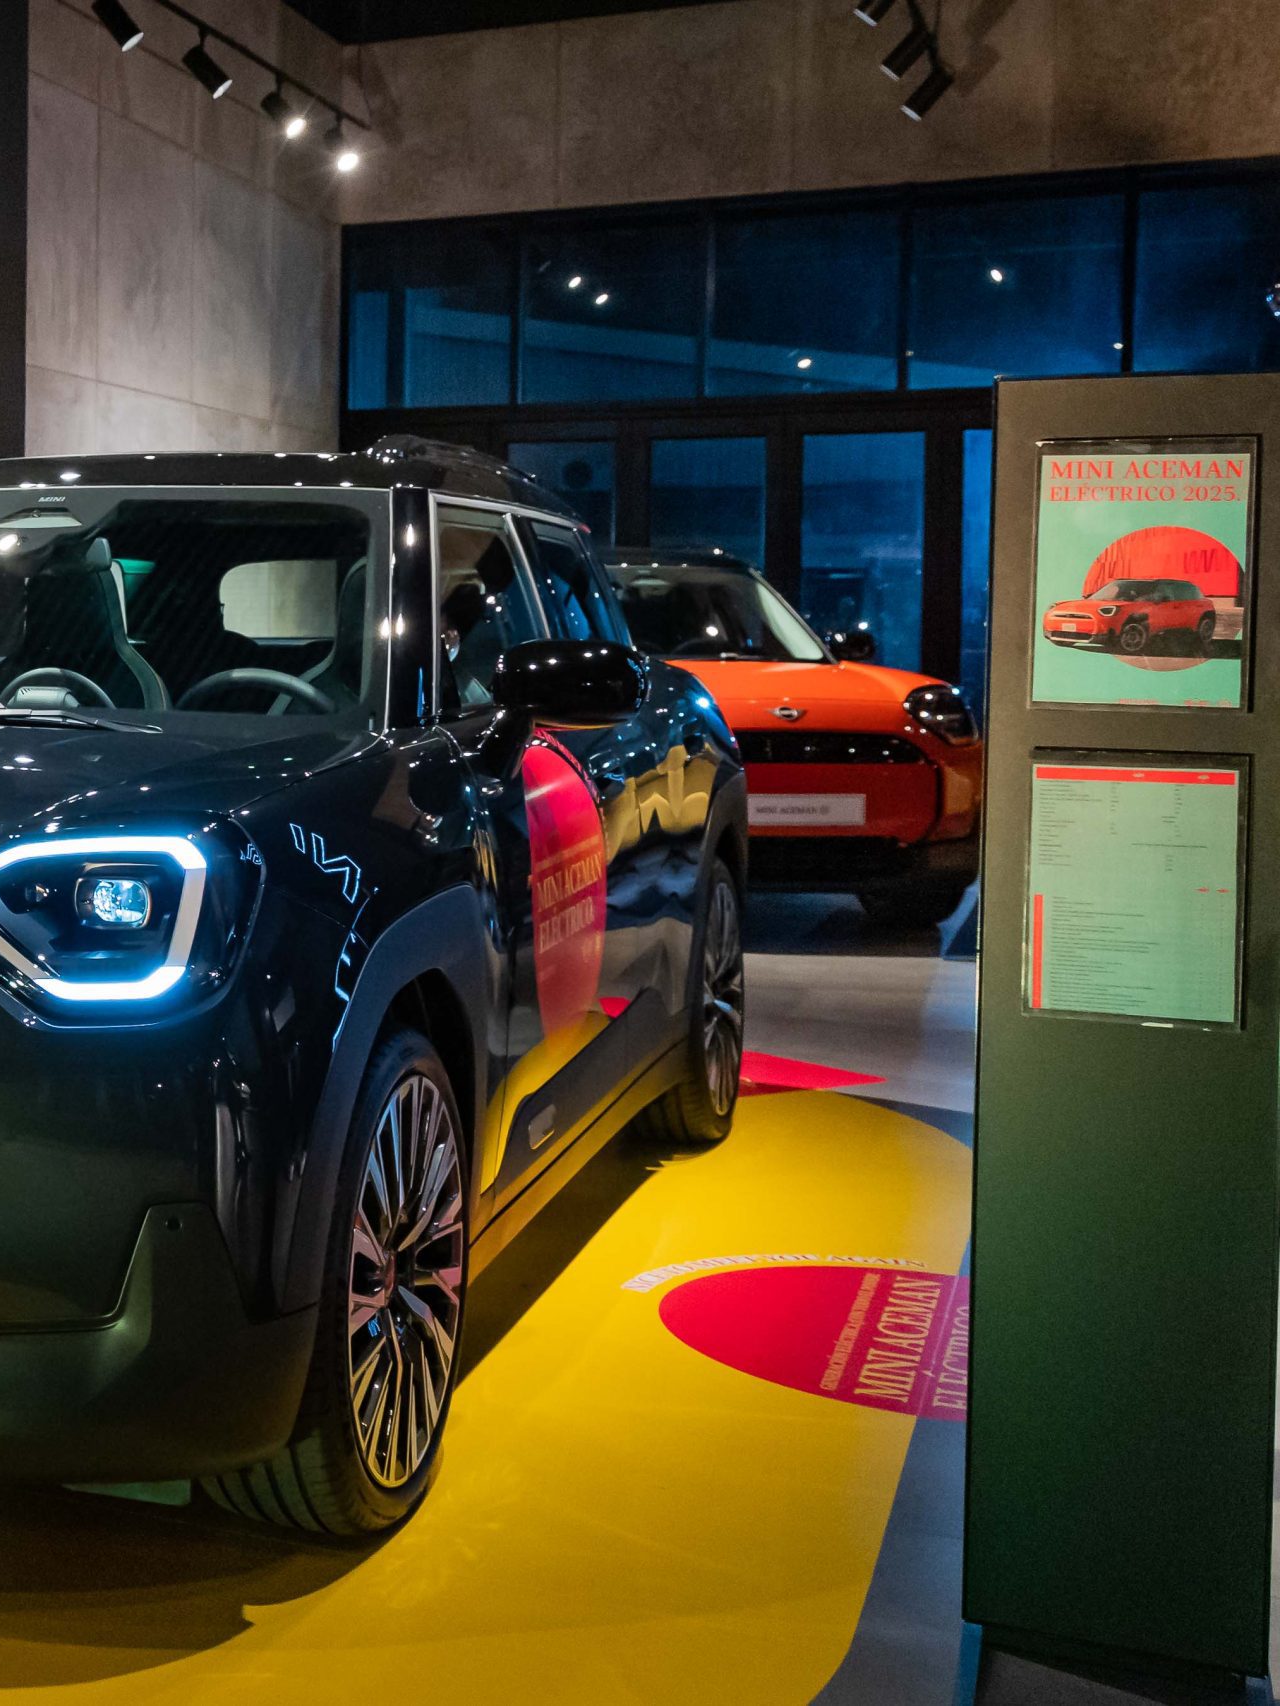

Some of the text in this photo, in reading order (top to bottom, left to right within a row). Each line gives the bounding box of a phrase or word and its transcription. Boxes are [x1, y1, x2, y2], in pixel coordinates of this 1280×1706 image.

[1050, 459, 1244, 480] MINI ACEMAN
[1050, 482, 1242, 502] ELÉCTRICO 2025.
[873, 1275, 945, 1353] ACEMAN
[853, 1347, 922, 1404] MINI
